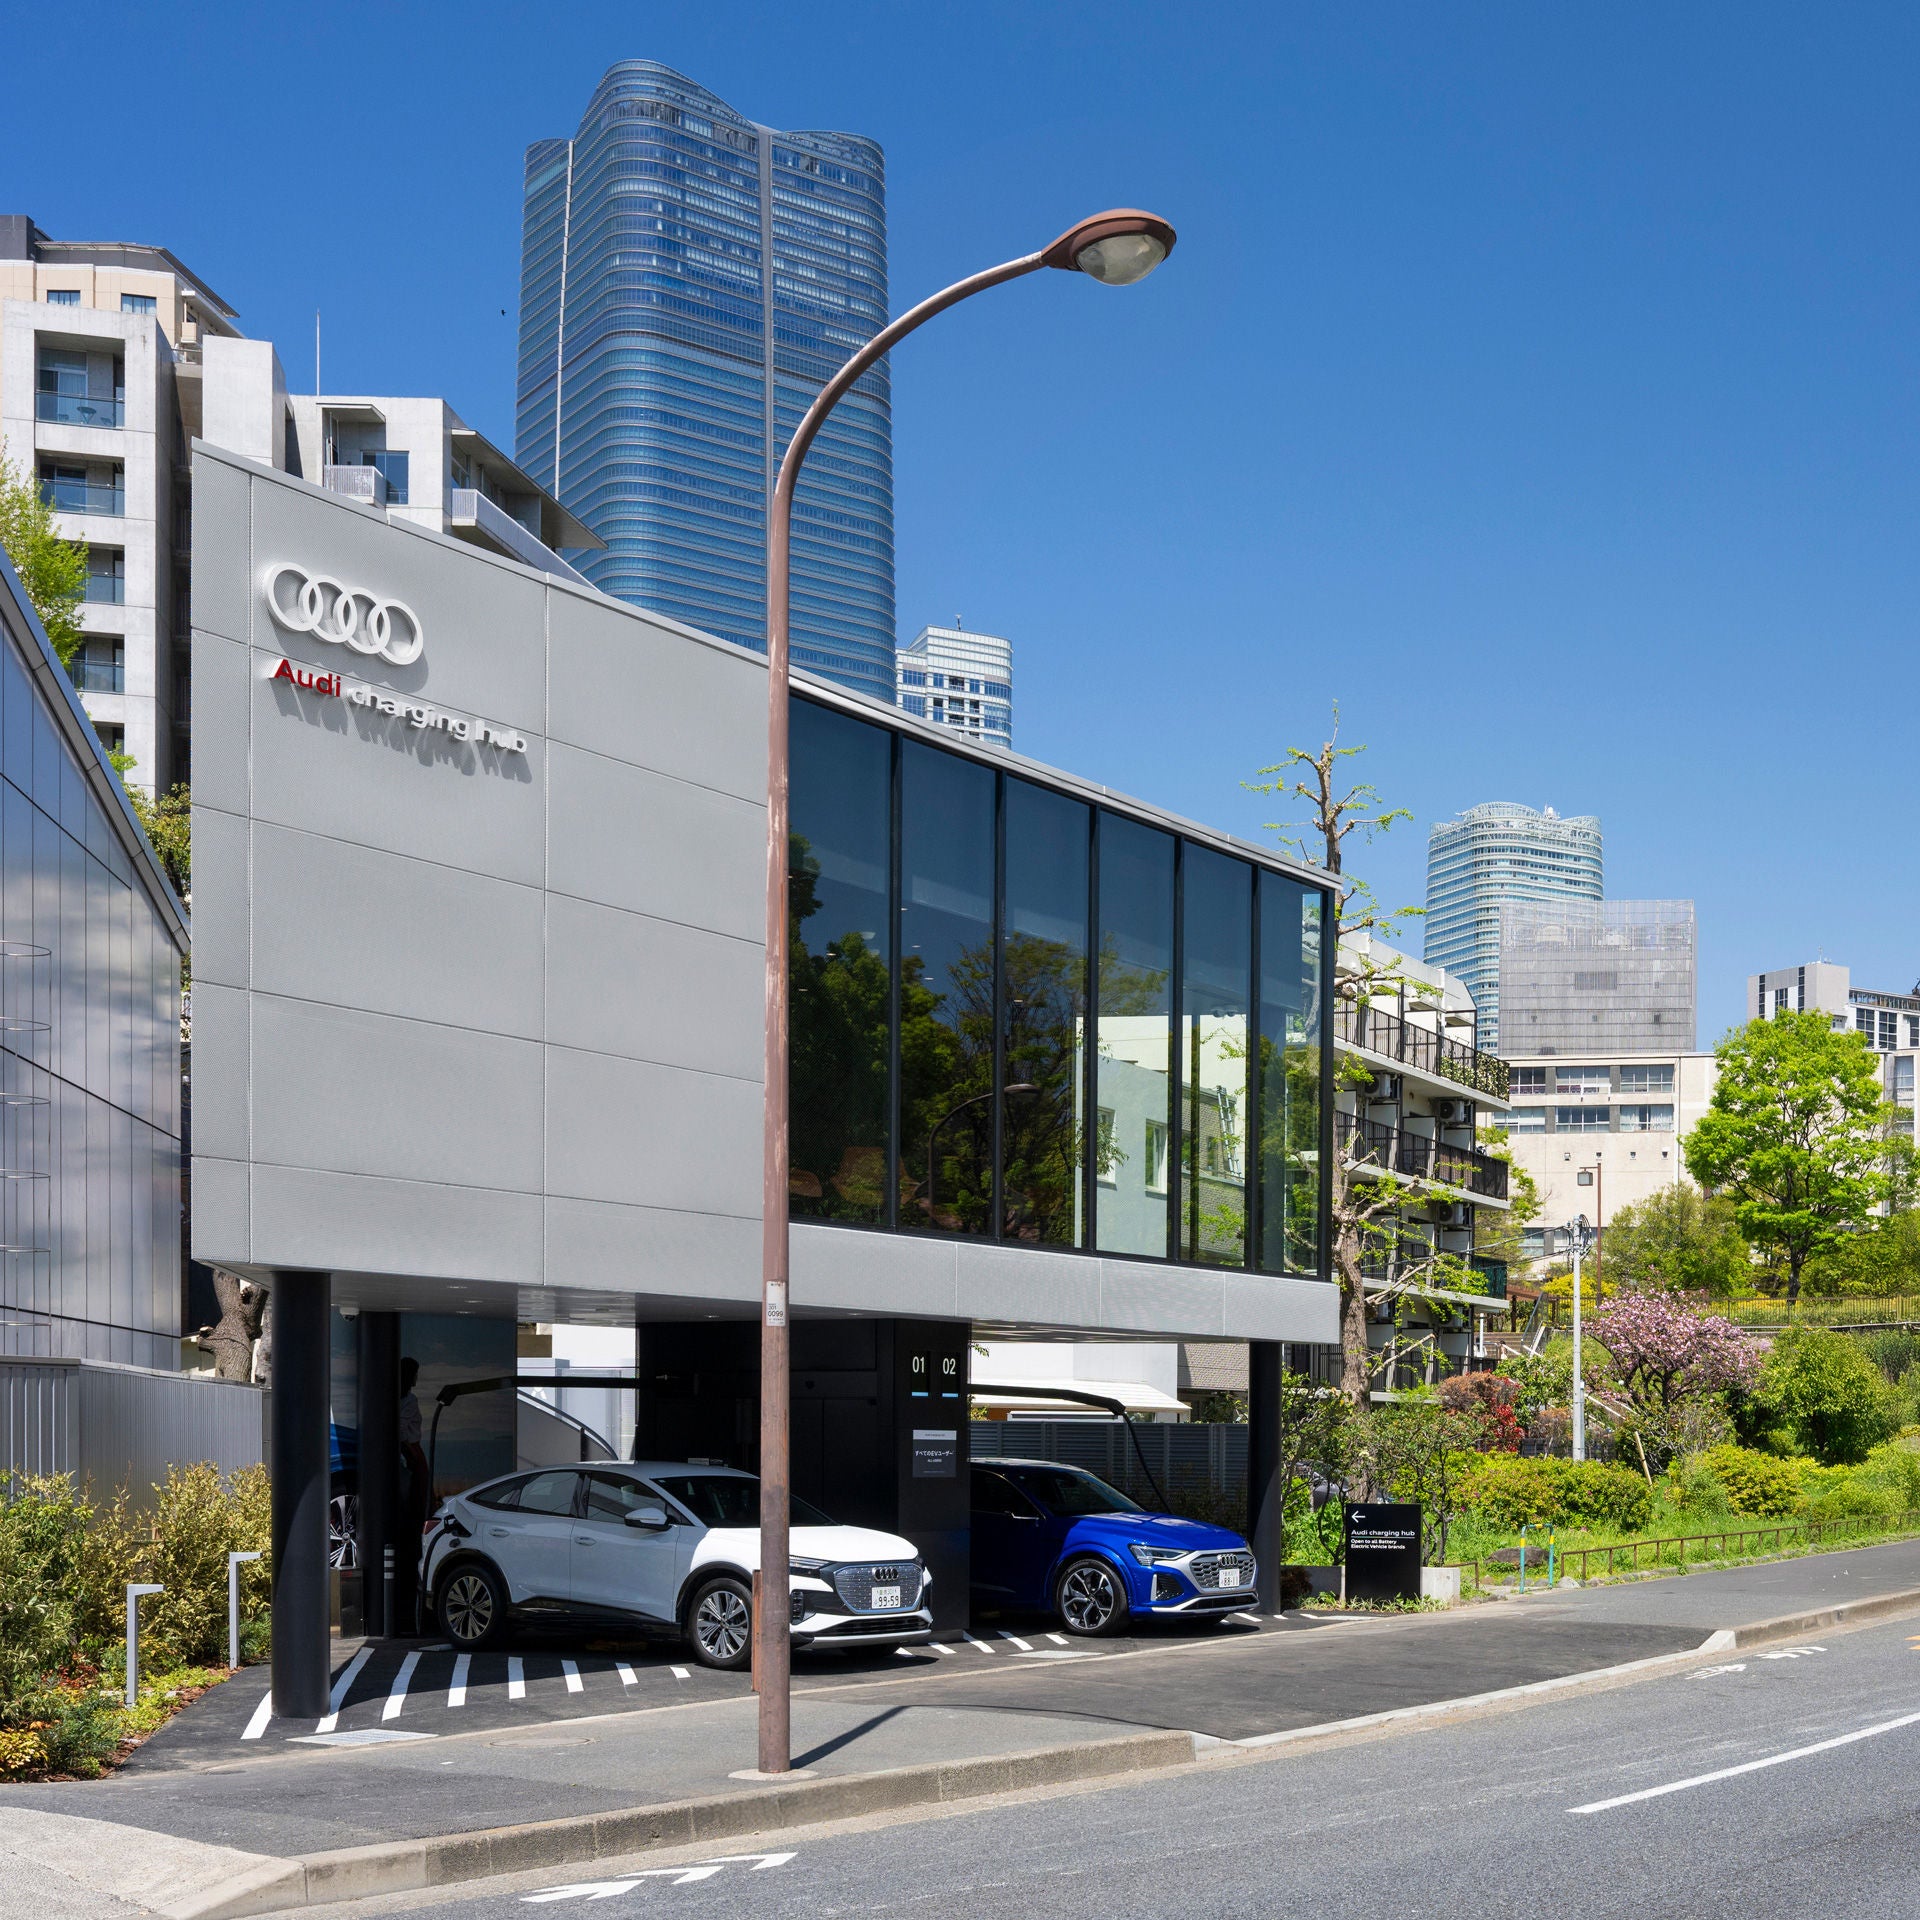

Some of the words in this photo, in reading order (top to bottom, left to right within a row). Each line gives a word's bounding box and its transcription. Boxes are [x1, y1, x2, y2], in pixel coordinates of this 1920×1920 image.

[273, 658, 341, 698] Audi
[349, 684, 470, 742] charging
[475, 719, 528, 753] hub
[912, 1356, 925, 1374] 01
[942, 1357, 956, 1375] 02
